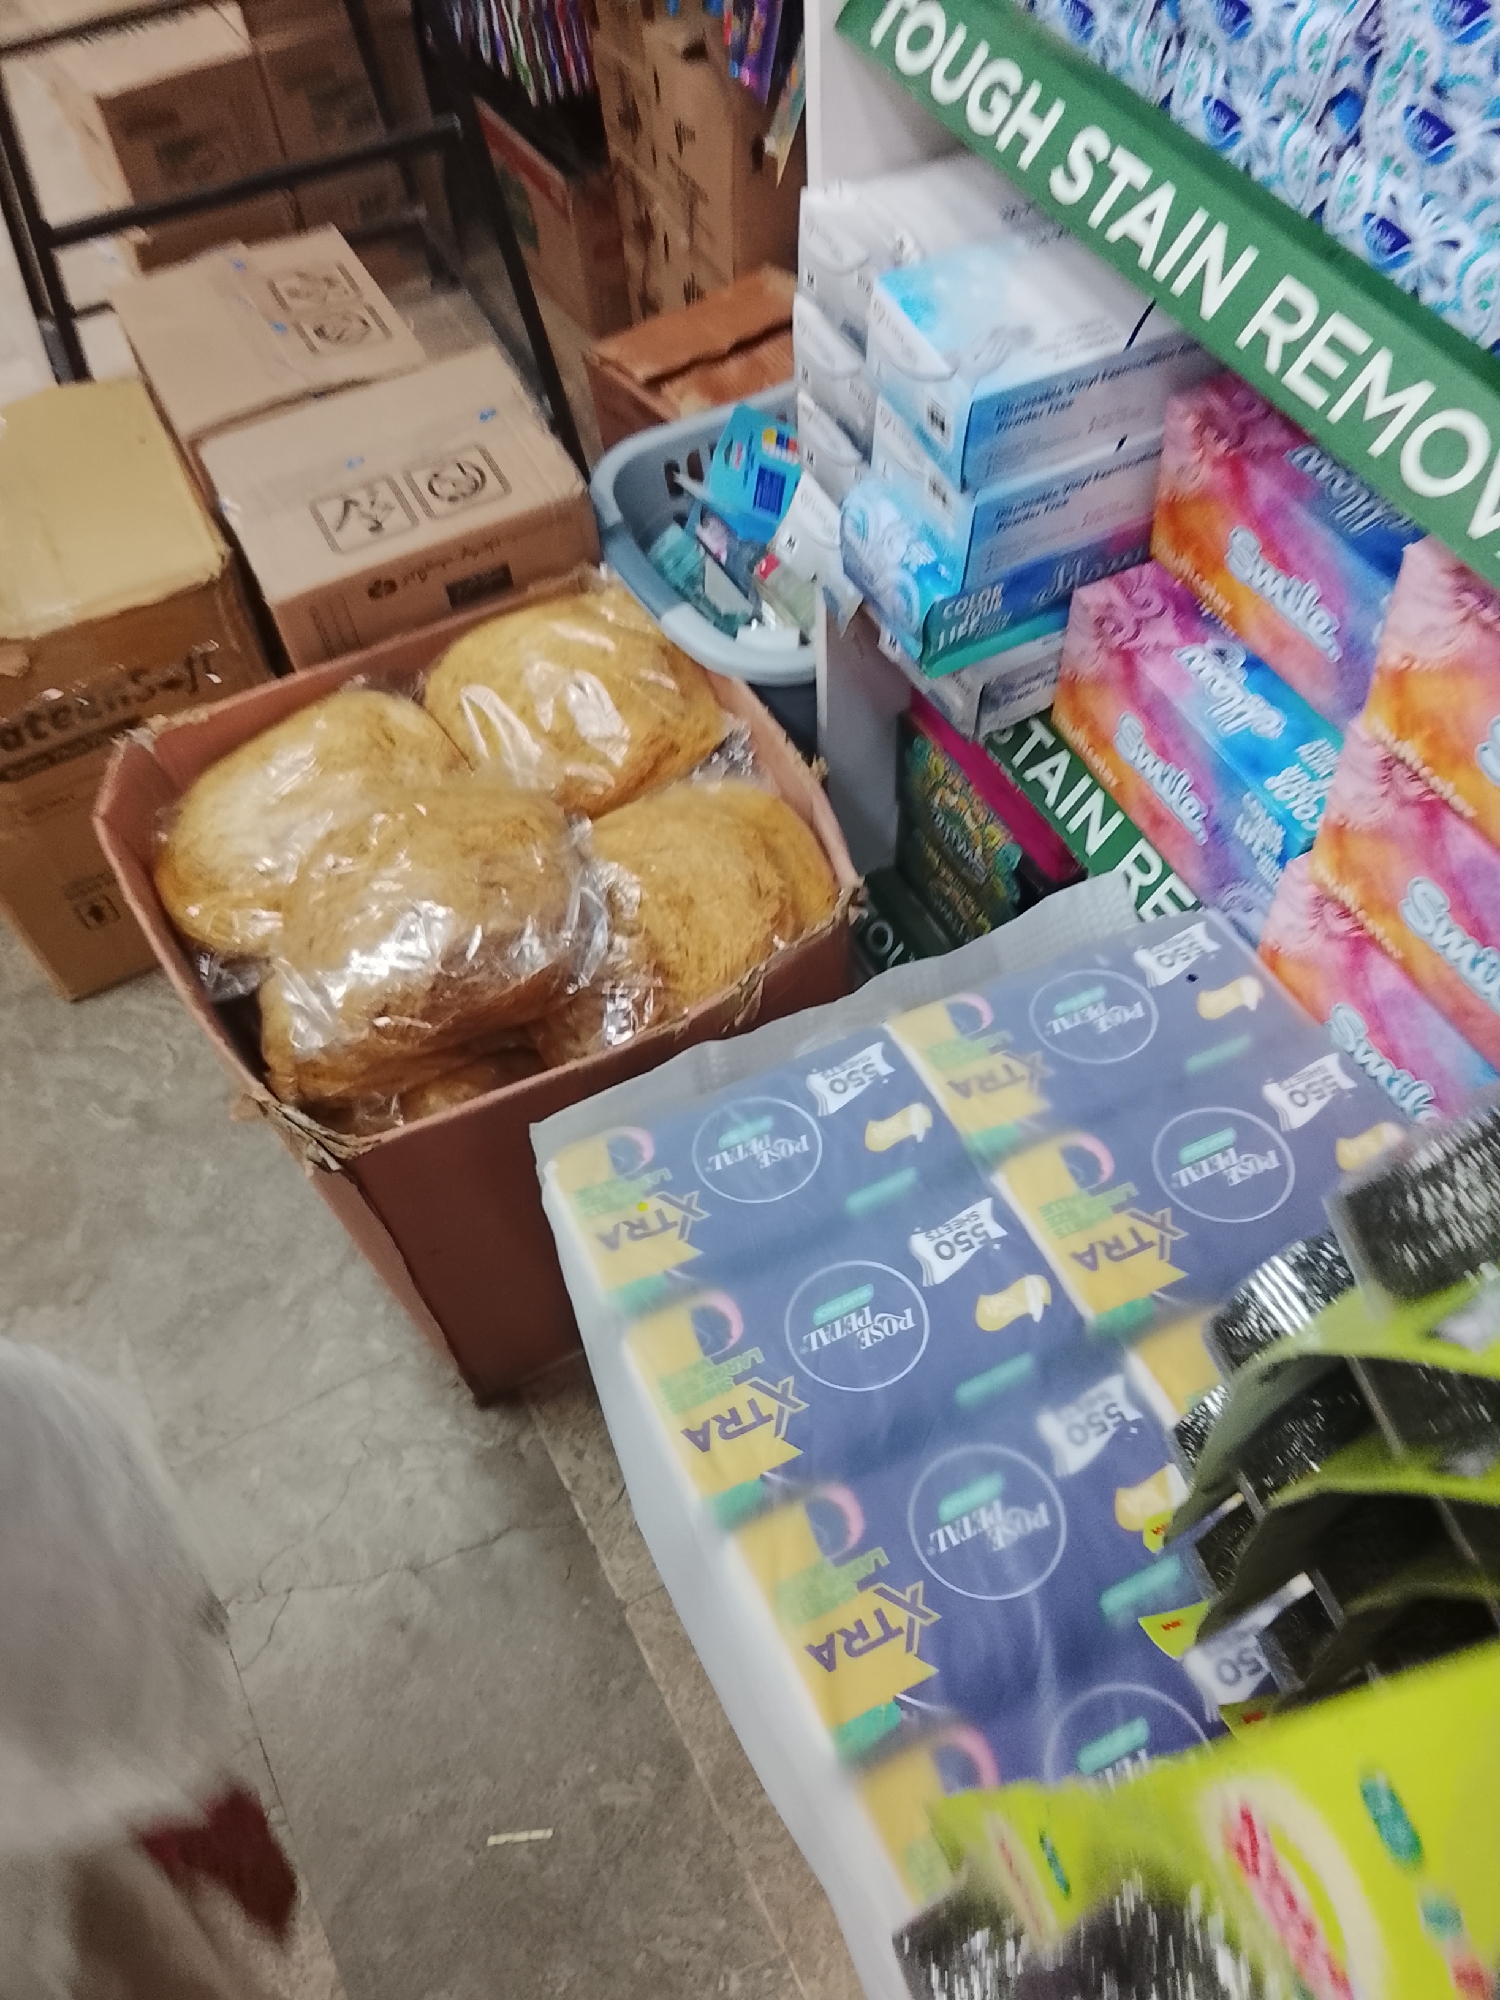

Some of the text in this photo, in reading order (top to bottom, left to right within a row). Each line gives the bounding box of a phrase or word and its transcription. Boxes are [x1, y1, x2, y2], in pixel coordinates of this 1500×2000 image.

[869, 0, 1067, 172] TOUGH
[1049, 125, 1260, 321] STAIN
[1234, 273, 1500, 540] REMOV
[990, 717, 1125, 857] TAIN
[829, 1063, 877, 1096] 550
[710, 1133, 772, 1172] PETAL
[759, 1134, 811, 1169] ROSE
[925, 1210, 981, 1243] SHEETS
[933, 1222, 995, 1262] 550
[803, 1306, 873, 1353] PETAL
[858, 1307, 918, 1350] ROSE
[680, 1375, 810, 1454] XTRA
[1067, 1402, 1127, 1447] 550
[805, 1580, 943, 1673] XTRA
[1215, 1648, 1266, 1687] 50
